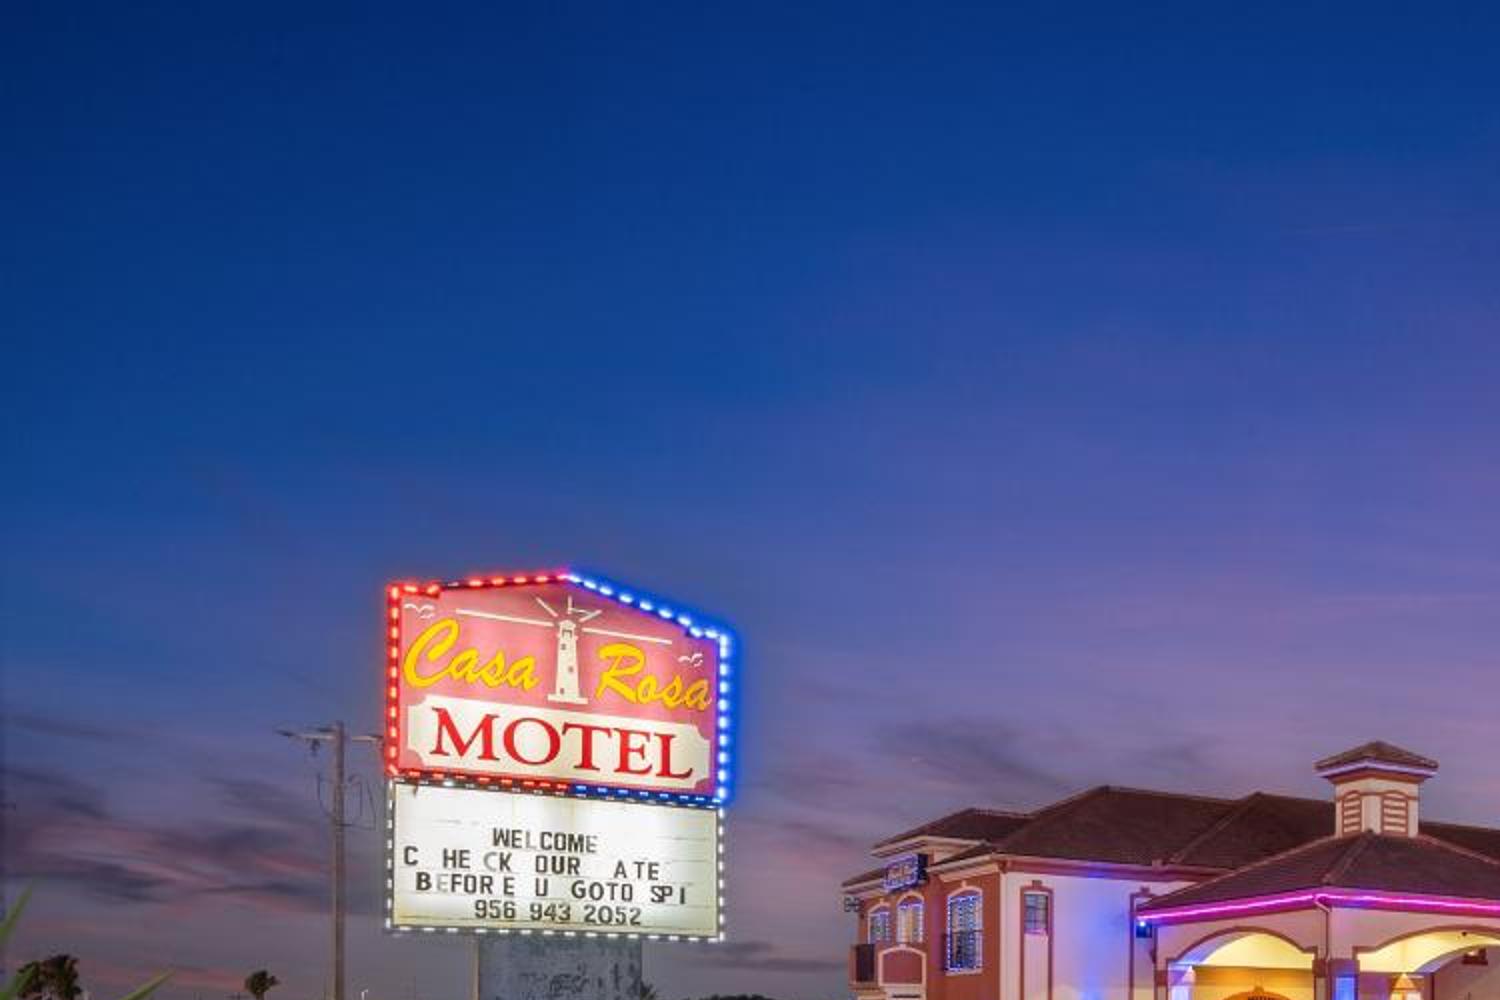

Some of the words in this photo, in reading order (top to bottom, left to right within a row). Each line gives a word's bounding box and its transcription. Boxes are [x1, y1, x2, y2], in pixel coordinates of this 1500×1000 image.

[402, 617, 539, 690] Casa
[594, 643, 713, 712] Rosa
[429, 706, 694, 780] MOTEL
[492, 827, 598, 854] WELCOME
[535, 855, 581, 875] OUR
[535, 878, 549, 897] U
[474, 899, 516, 920] 956
[529, 902, 572, 922] 943
[583, 904, 642, 926] 2052
